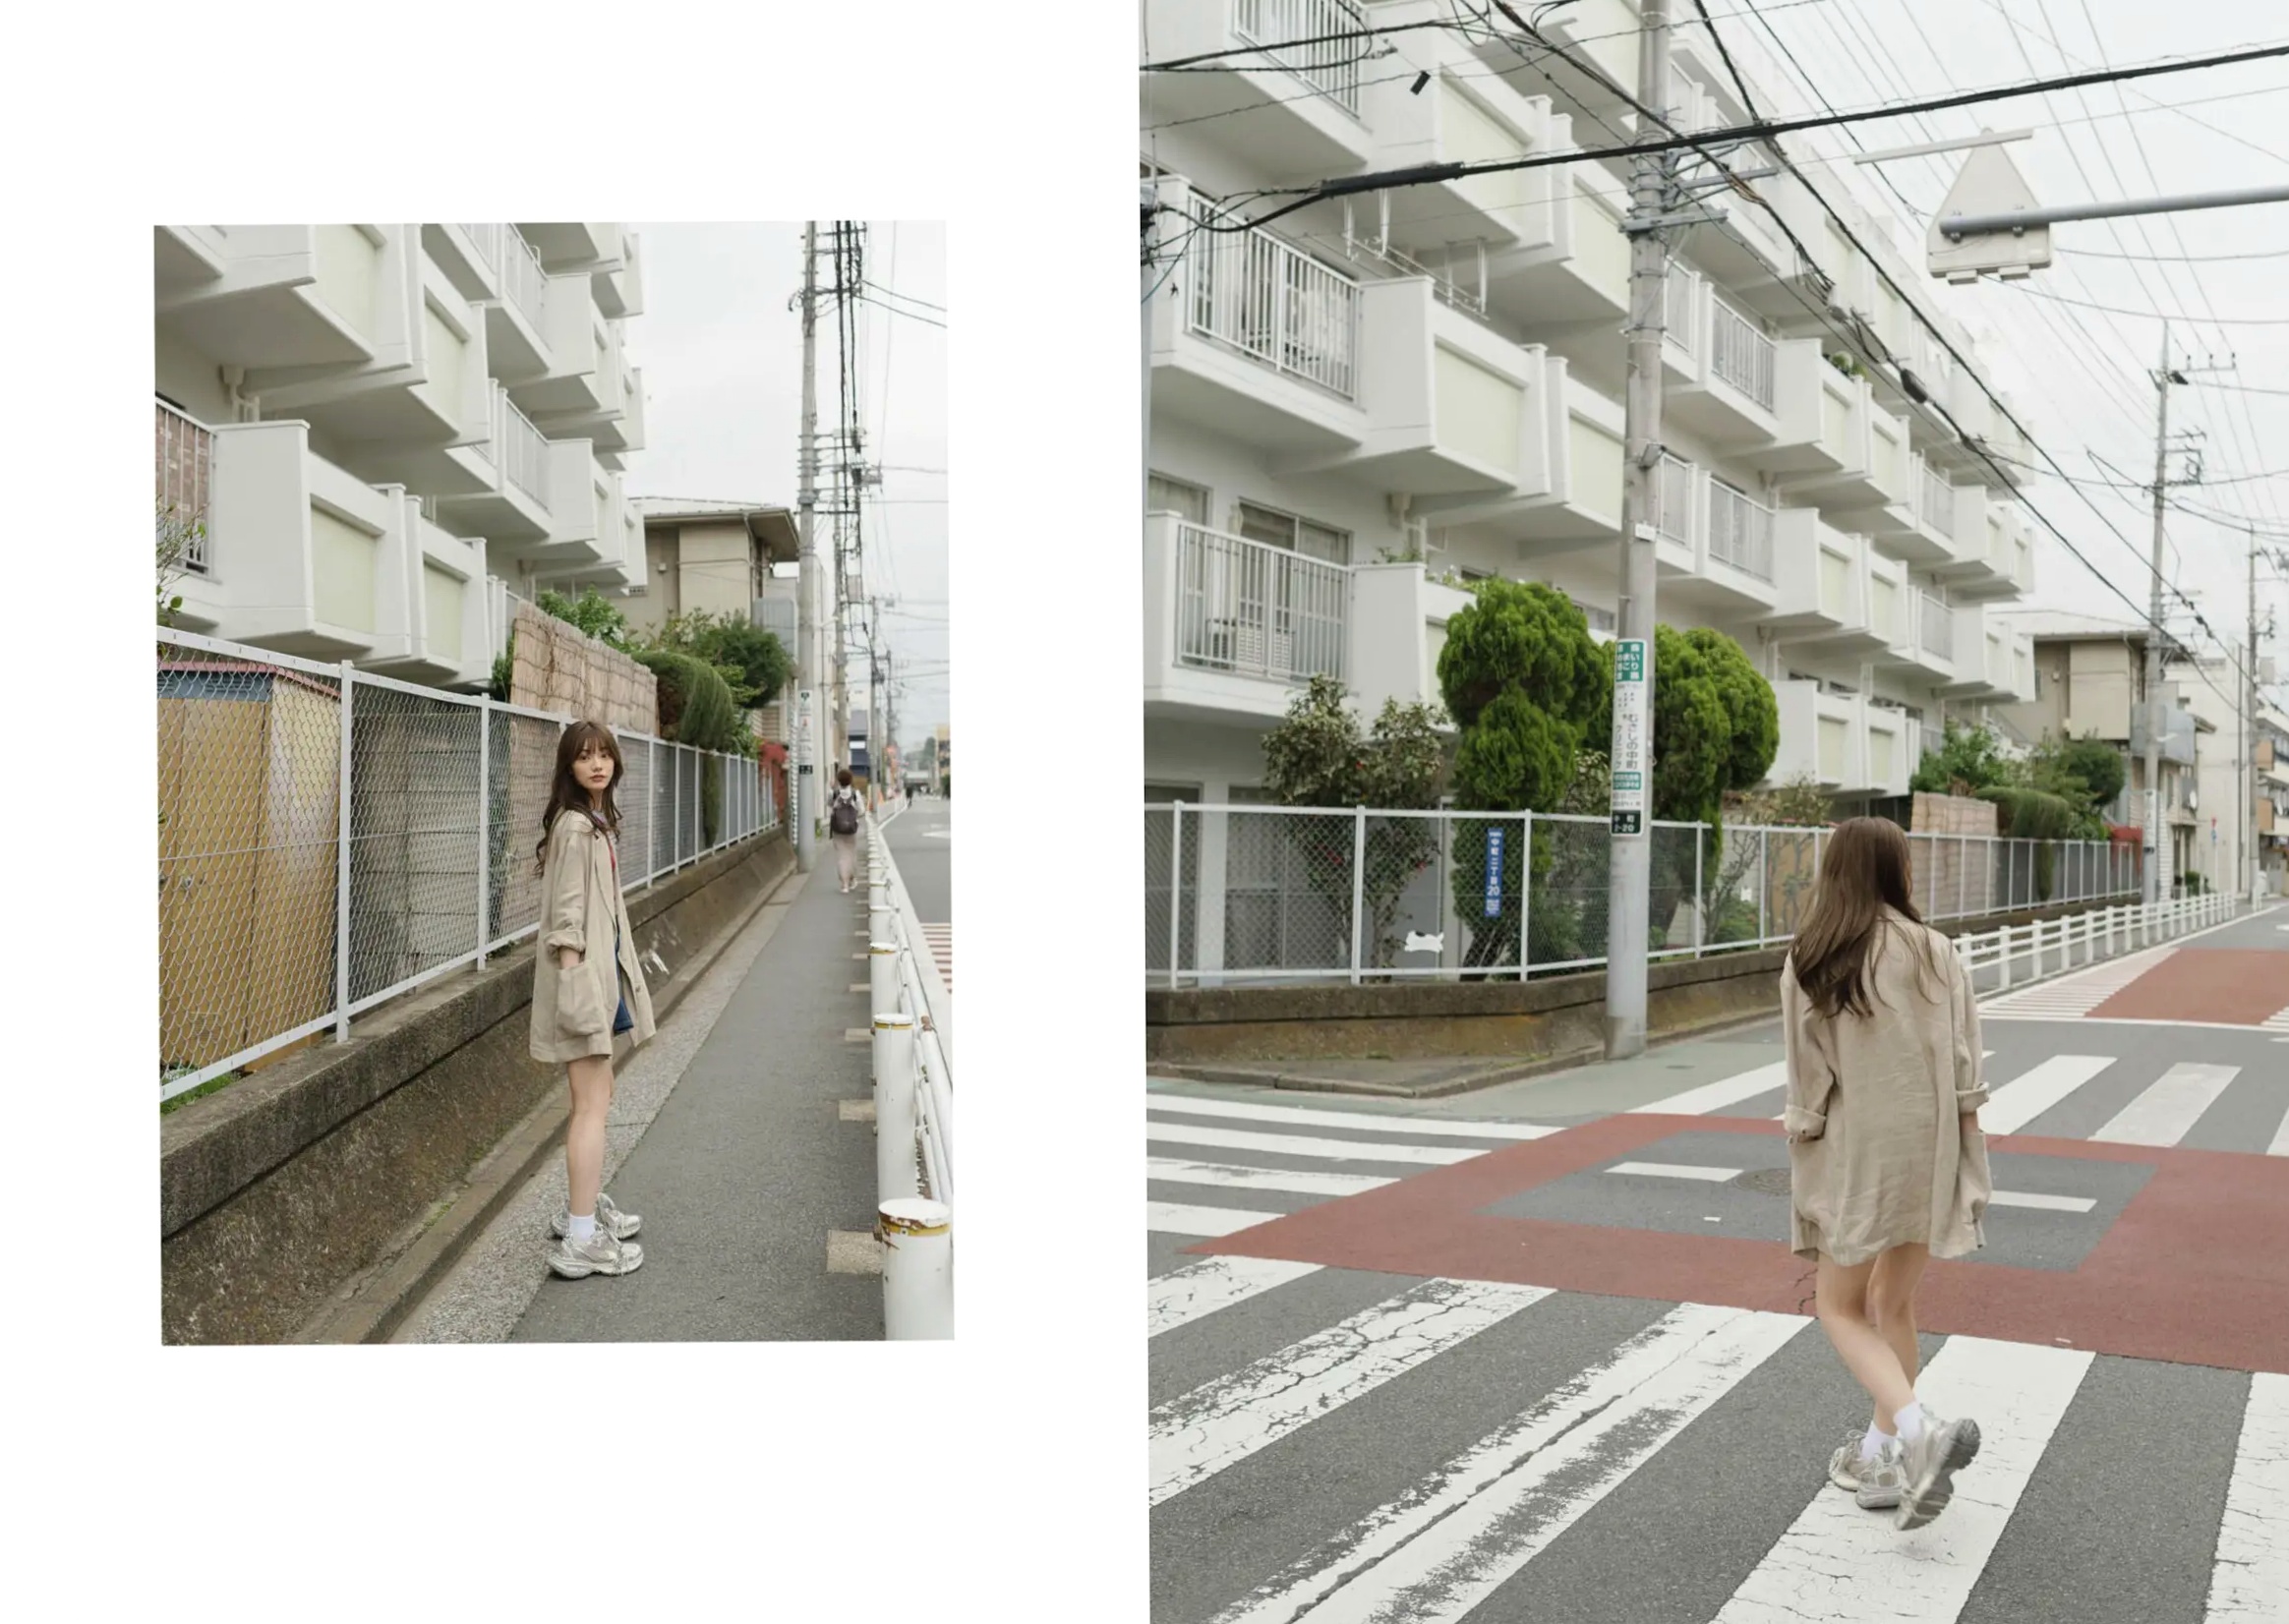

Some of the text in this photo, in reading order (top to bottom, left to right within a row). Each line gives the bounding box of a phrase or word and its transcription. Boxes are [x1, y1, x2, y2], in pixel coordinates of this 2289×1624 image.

[1626, 714, 1638, 770] むさしの中町
[1487, 886, 1500, 897] 20
